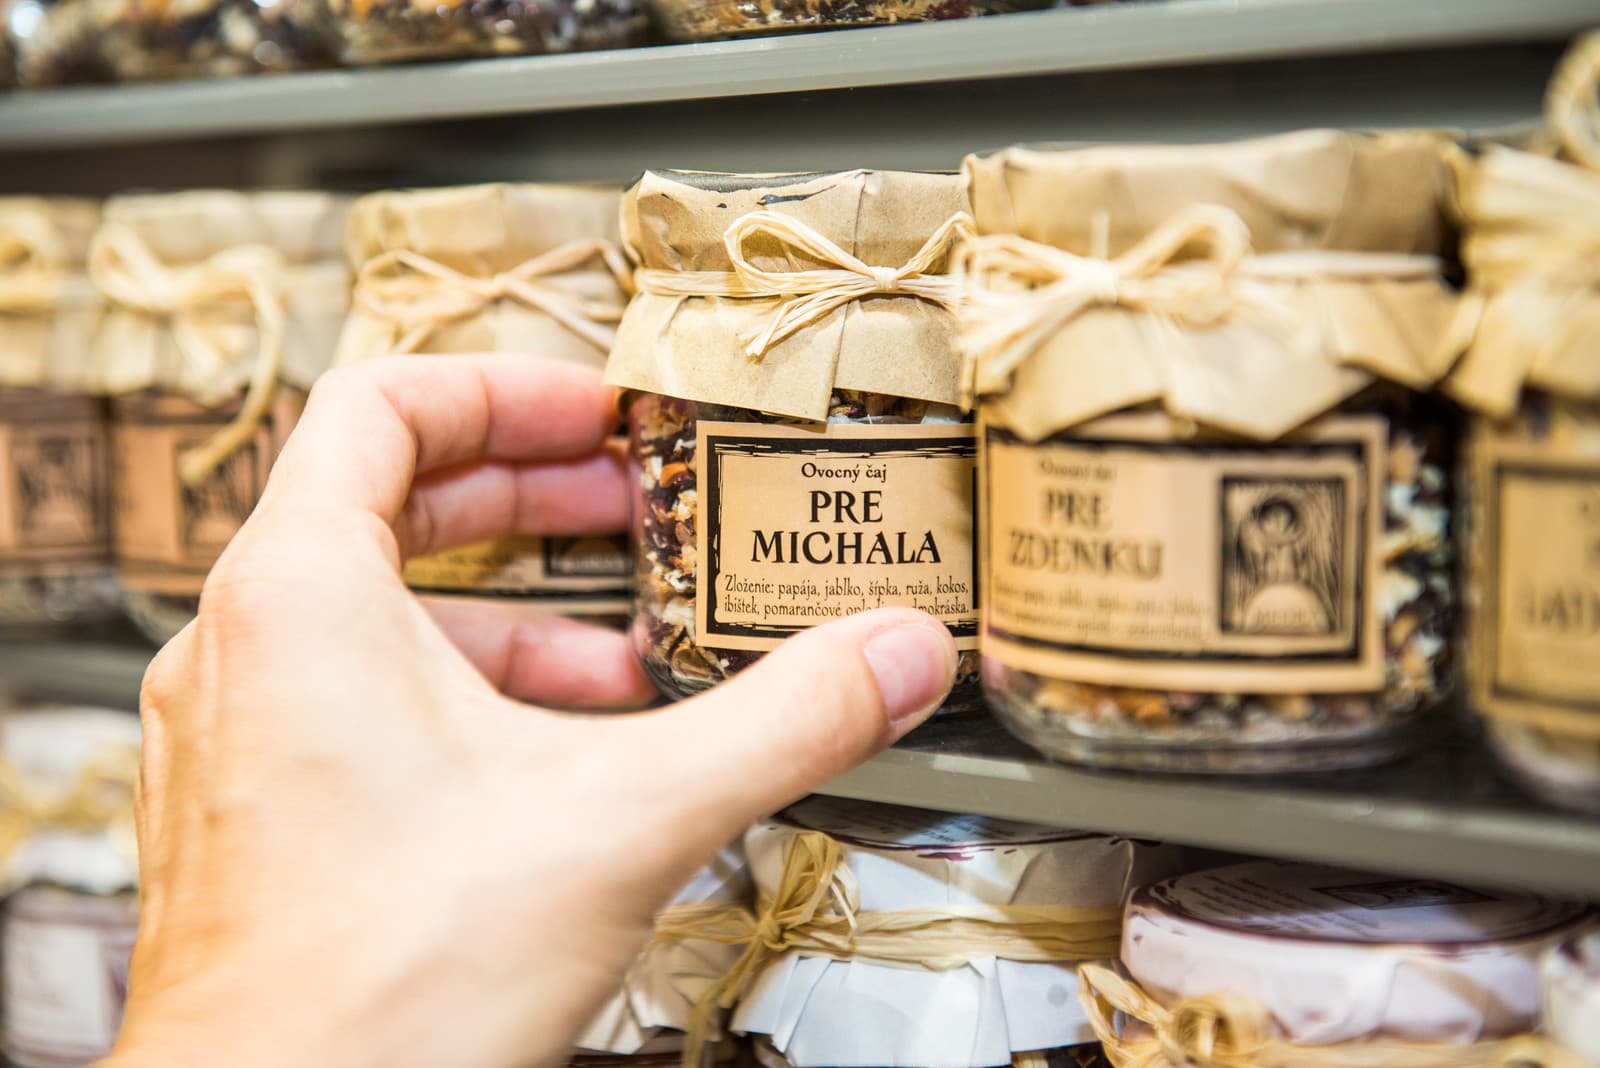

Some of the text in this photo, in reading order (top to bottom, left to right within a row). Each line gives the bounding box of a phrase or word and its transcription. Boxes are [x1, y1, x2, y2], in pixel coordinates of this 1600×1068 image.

[801, 462, 887, 483] Ovocný čaj
[808, 490, 883, 525] PRE
[750, 529, 942, 565] MICHALA
[724, 573, 969, 601] Zloženie: papája, jablko, šípka, ruža, kokos,
[724, 594, 761, 615] ibištek,
[763, 601, 842, 620] pomarančové
